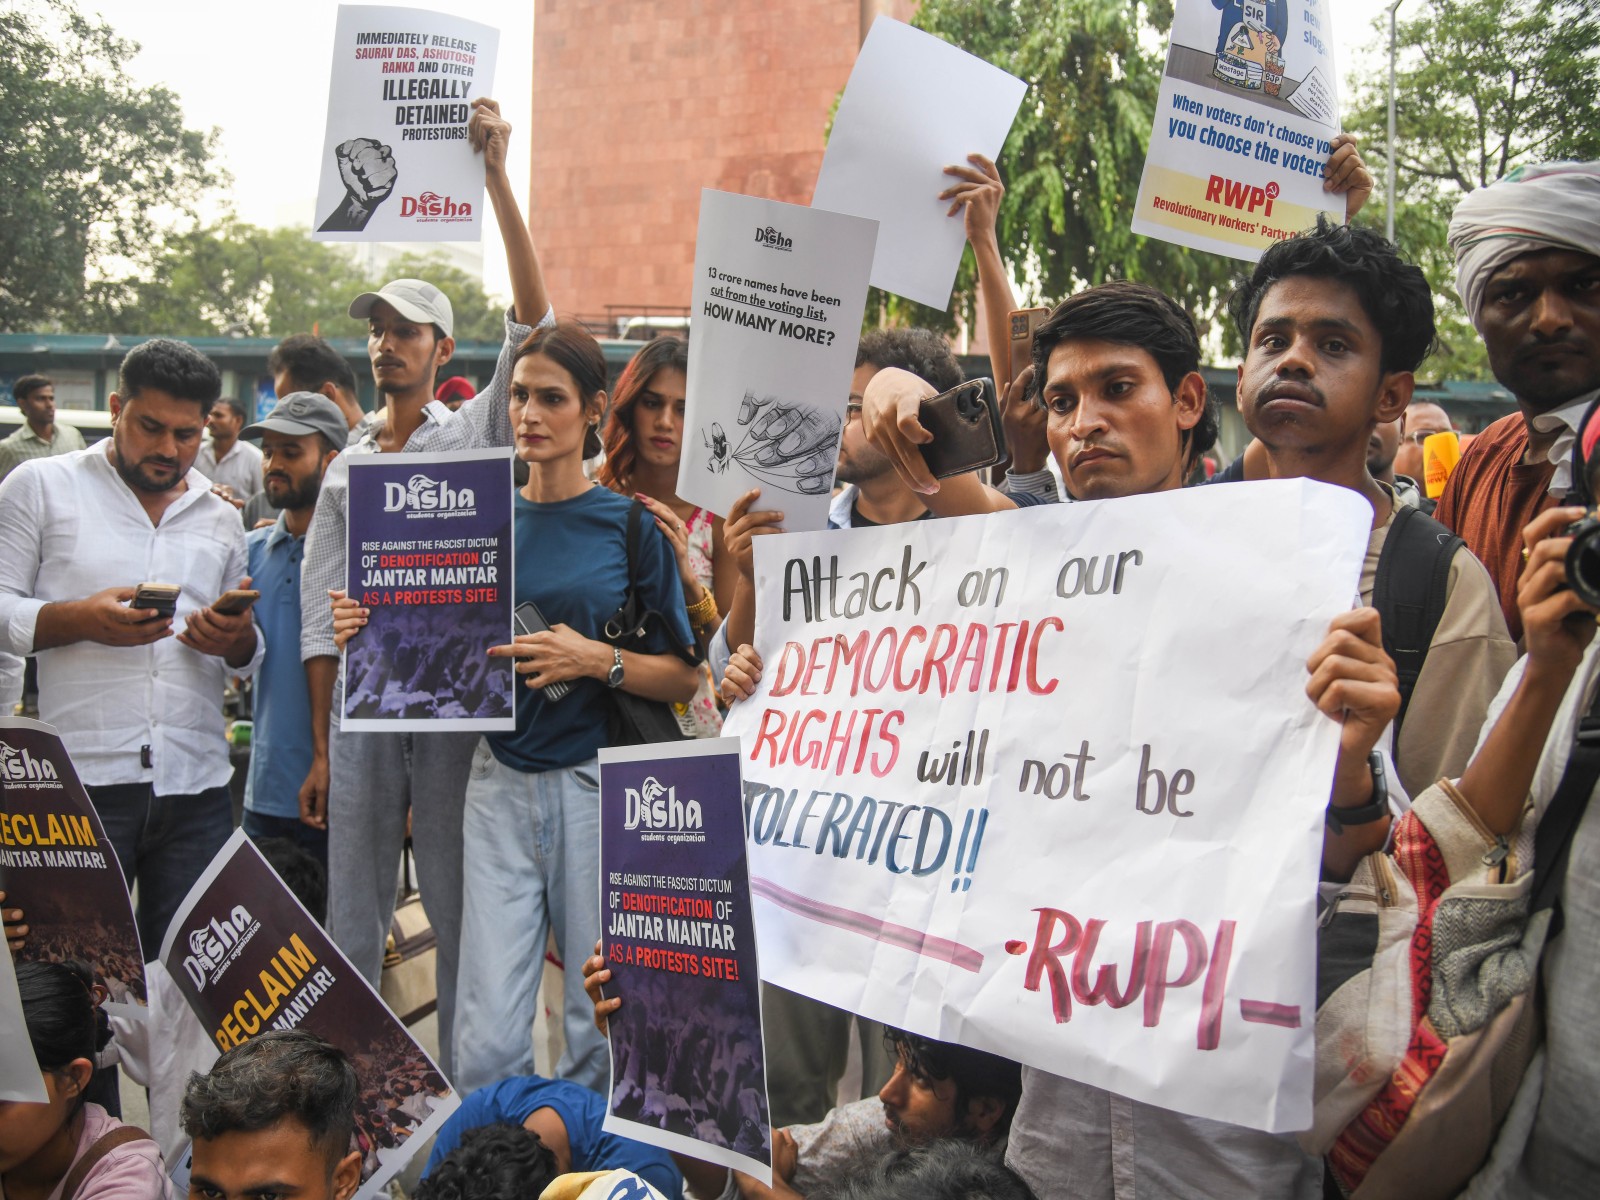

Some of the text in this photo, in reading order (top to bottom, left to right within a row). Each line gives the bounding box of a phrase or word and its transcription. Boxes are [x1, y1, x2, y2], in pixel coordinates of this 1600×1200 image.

[1245, 6, 1264, 22] SIR
[356, 32, 477, 53] IMMEDIATELY RELEASE
[356, 48, 475, 65] SAURAV DAS, ASHUTOSH
[382, 62, 474, 77] RANKA AND OTHER
[1266, 74, 1280, 84] BJP
[383, 78, 472, 100] ILLEGALLY
[396, 104, 468, 125] DETAINED
[1172, 94, 1203, 116] When
[1206, 105, 1242, 128] voters
[1244, 116, 1275, 138] don't
[1276, 126, 1314, 150] choose
[402, 127, 468, 140] PROTESTORS!
[1169, 118, 1196, 138] you
[1200, 124, 1251, 157] choose
[1254, 140, 1279, 165] the
[400, 191, 472, 217] Disha
[1153, 196, 1217, 226] Revolutionary
[1218, 211, 1260, 234] Workers'
[1261, 225, 1288, 240] Party
[755, 226, 792, 247] Disha
[708, 267, 841, 307] 13 crore names have been
[710, 285, 828, 322] cut from the voting list,
[704, 302, 836, 346] HOW MANY MORE?
[384, 474, 475, 512] Disha
[362, 538, 498, 551] RISE AGAINST THE FASCIST DICTUM
[362, 551, 498, 568] OF DENOTIFICATION OF
[362, 566, 497, 587] JANTAR MANTAR
[782, 544, 1143, 624] Attack on our
[362, 588, 497, 605] AS A PROTESTS SITE!
[768, 616, 1065, 699] DEMOCRATIC
[0, 740, 58, 781] isha
[750, 708, 1196, 818] RIGHTS will not be
[624, 776, 703, 832] Disha
[0, 812, 98, 846] ECLAIM
[667, 832, 705, 844] organization
[0, 849, 107, 869] ANTAR MANTAR!
[609, 872, 732, 893] RISE AGAINST THE FASCIST DICTUM
[609, 891, 733, 920] OF DENOTIFICATION OF
[183, 904, 252, 993] Disha
[231, 922, 261, 960] organization
[609, 913, 735, 951] JANTAR MANTAR
[609, 943, 739, 981] AS A PROTESTS SITE!
[215, 932, 317, 1052] RECLAIM
[272, 965, 336, 1030] MANTAR!
